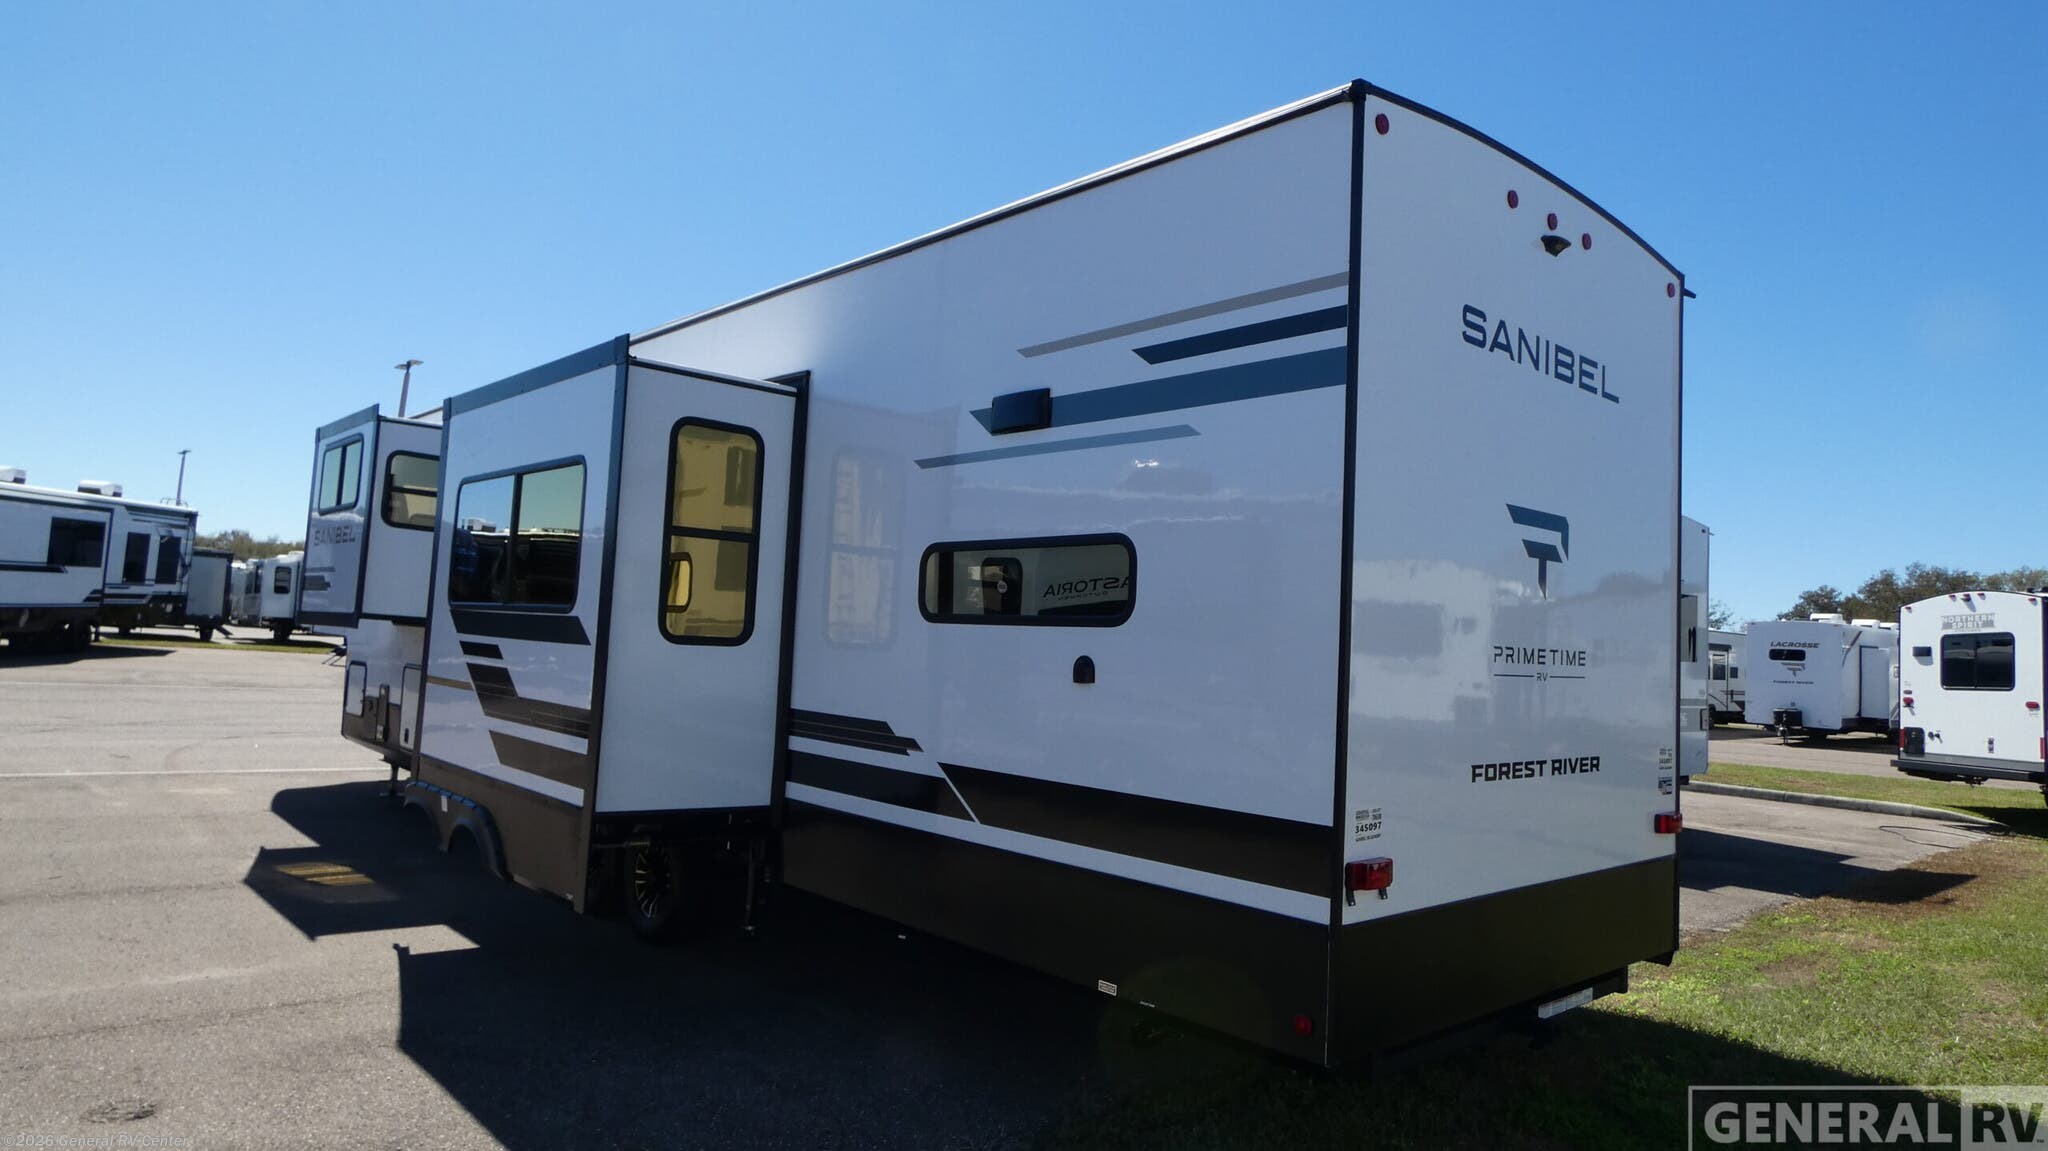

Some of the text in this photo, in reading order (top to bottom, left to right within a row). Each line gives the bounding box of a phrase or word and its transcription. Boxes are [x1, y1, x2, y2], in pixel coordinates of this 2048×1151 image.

[1461, 303, 1620, 404] SANIBEL
[314, 524, 356, 546] SANIBEL
[1941, 614, 1995, 624] NORTHERN
[1952, 621, 1983, 630] SPIRIT
[1770, 641, 1821, 649] LACROSSE
[1492, 645, 1587, 667] PRIME TIME
[1536, 672, 1549, 682] RV
[1471, 756, 1600, 783] FOREST RIVER
[1355, 821, 1382, 833] 345097
